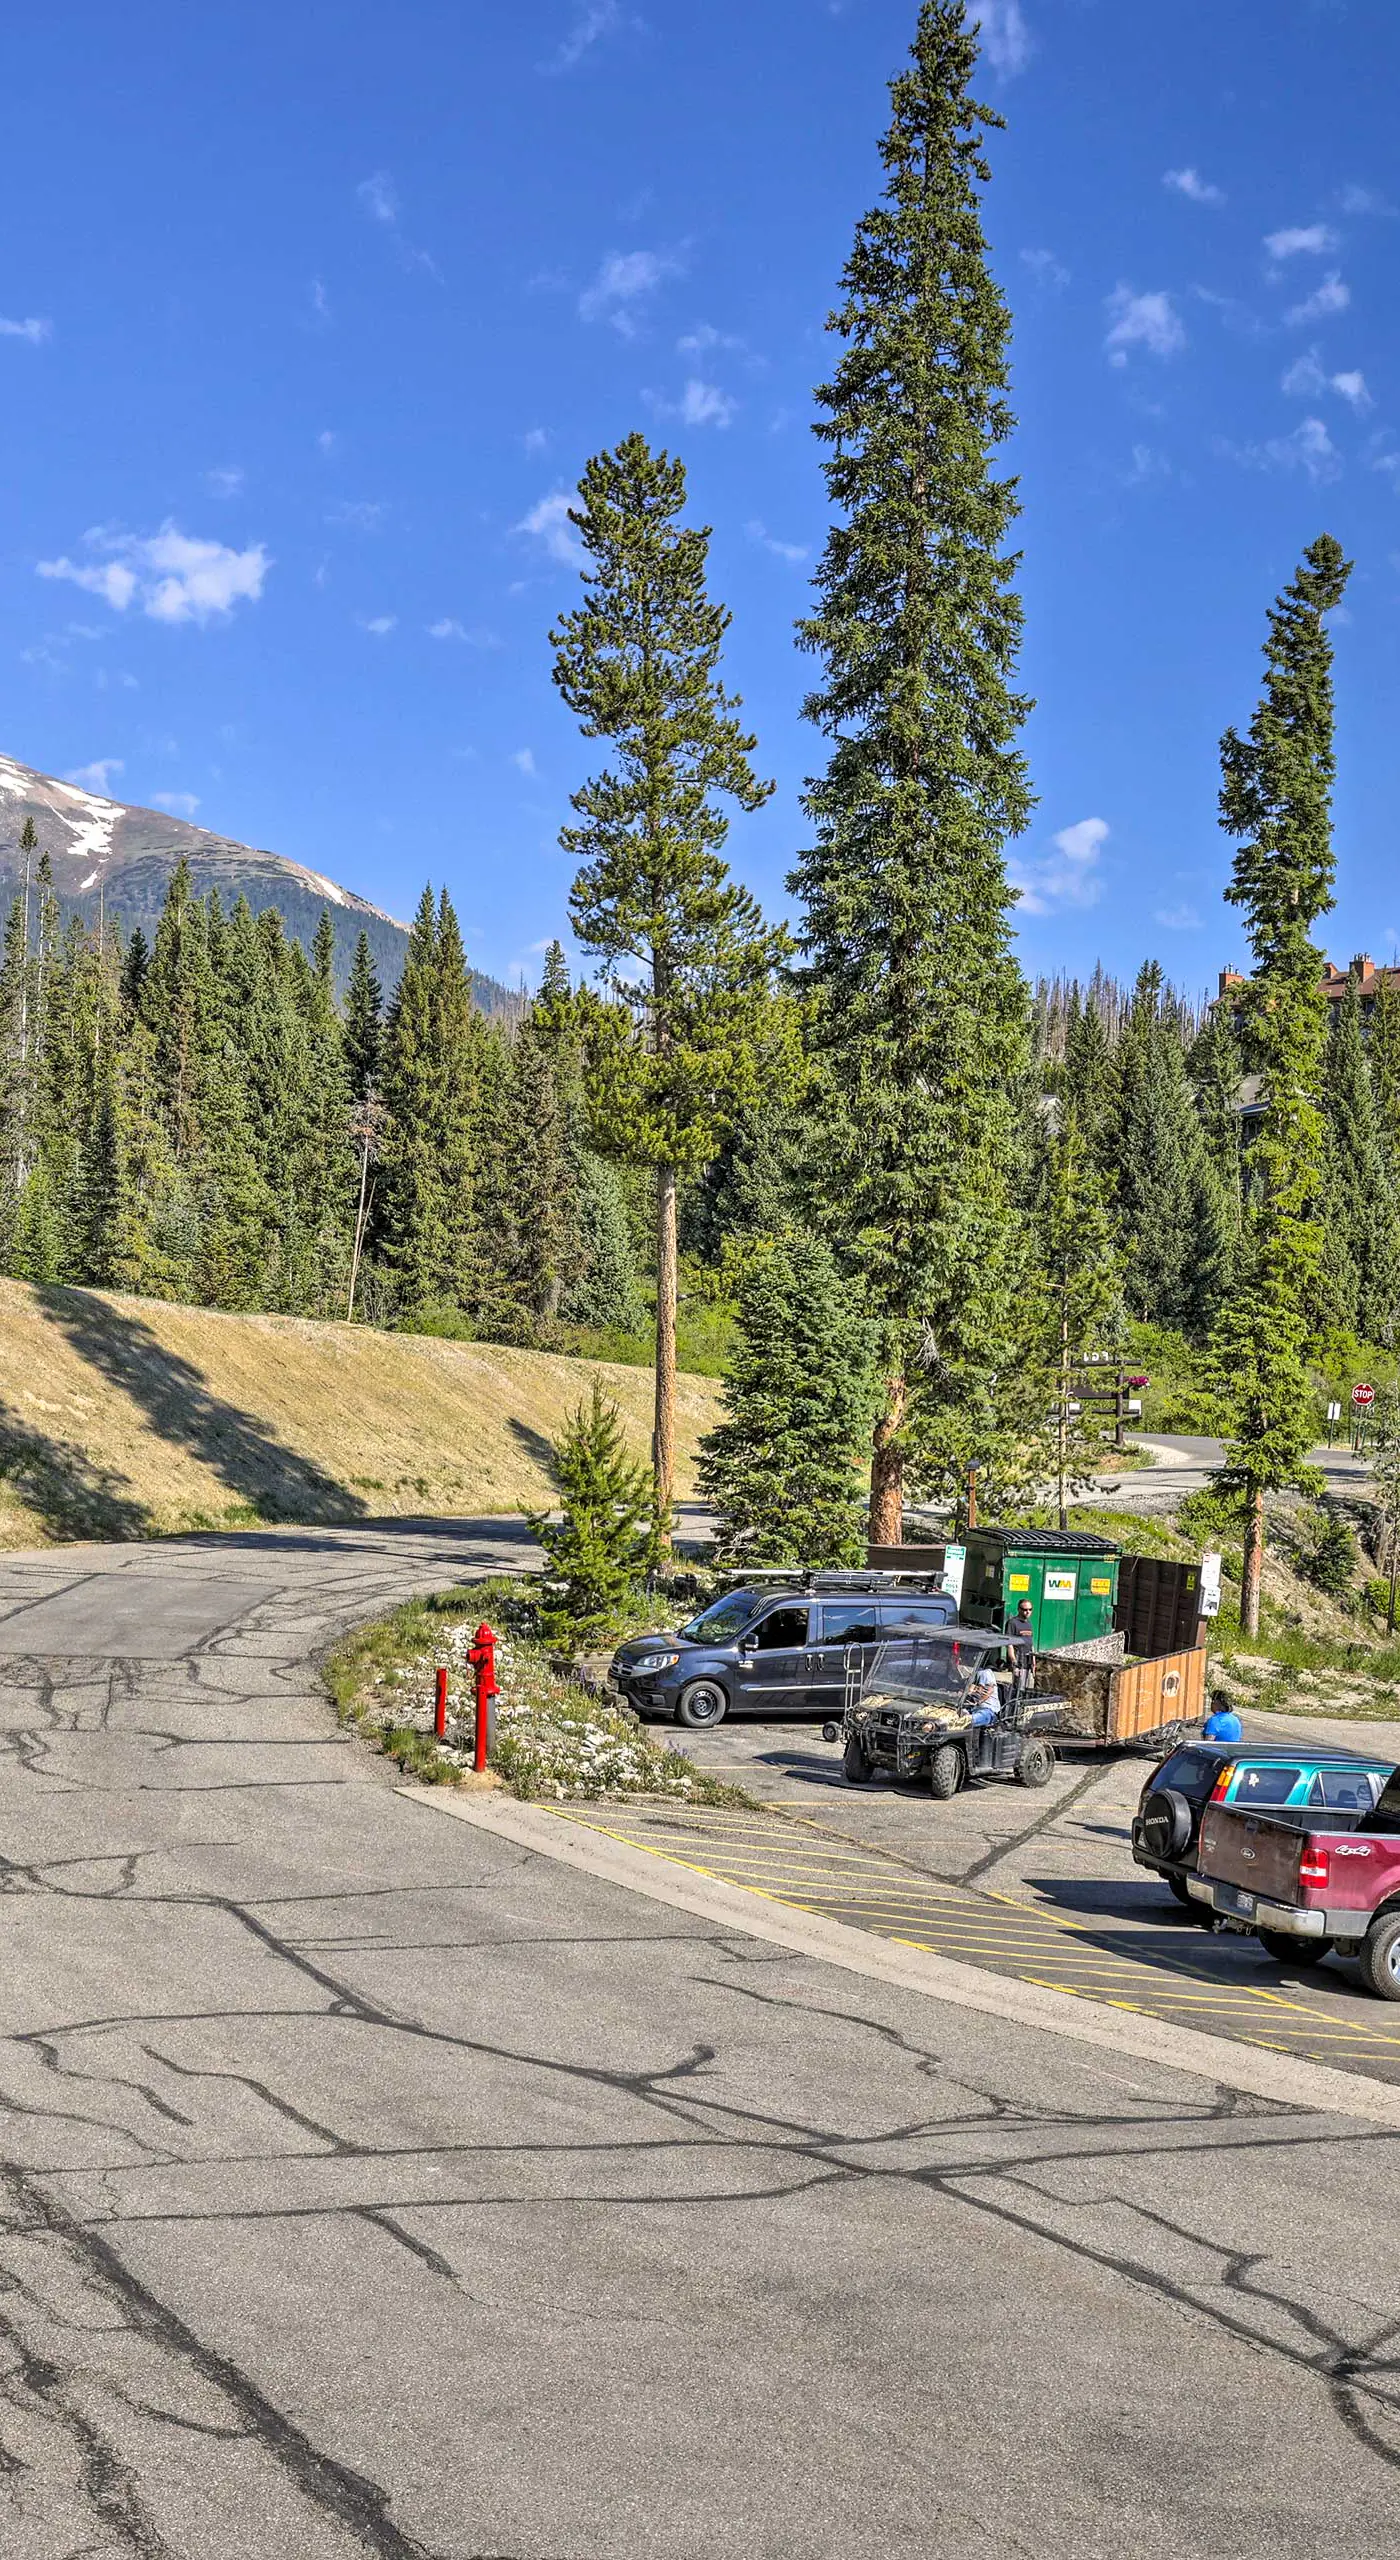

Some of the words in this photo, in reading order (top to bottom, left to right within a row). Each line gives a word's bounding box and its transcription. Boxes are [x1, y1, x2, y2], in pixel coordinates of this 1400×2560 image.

[1354, 1389, 1373, 1399] STOP
[1048, 1579, 1072, 1589] WM
[1145, 1816, 1169, 1826] HONDA
